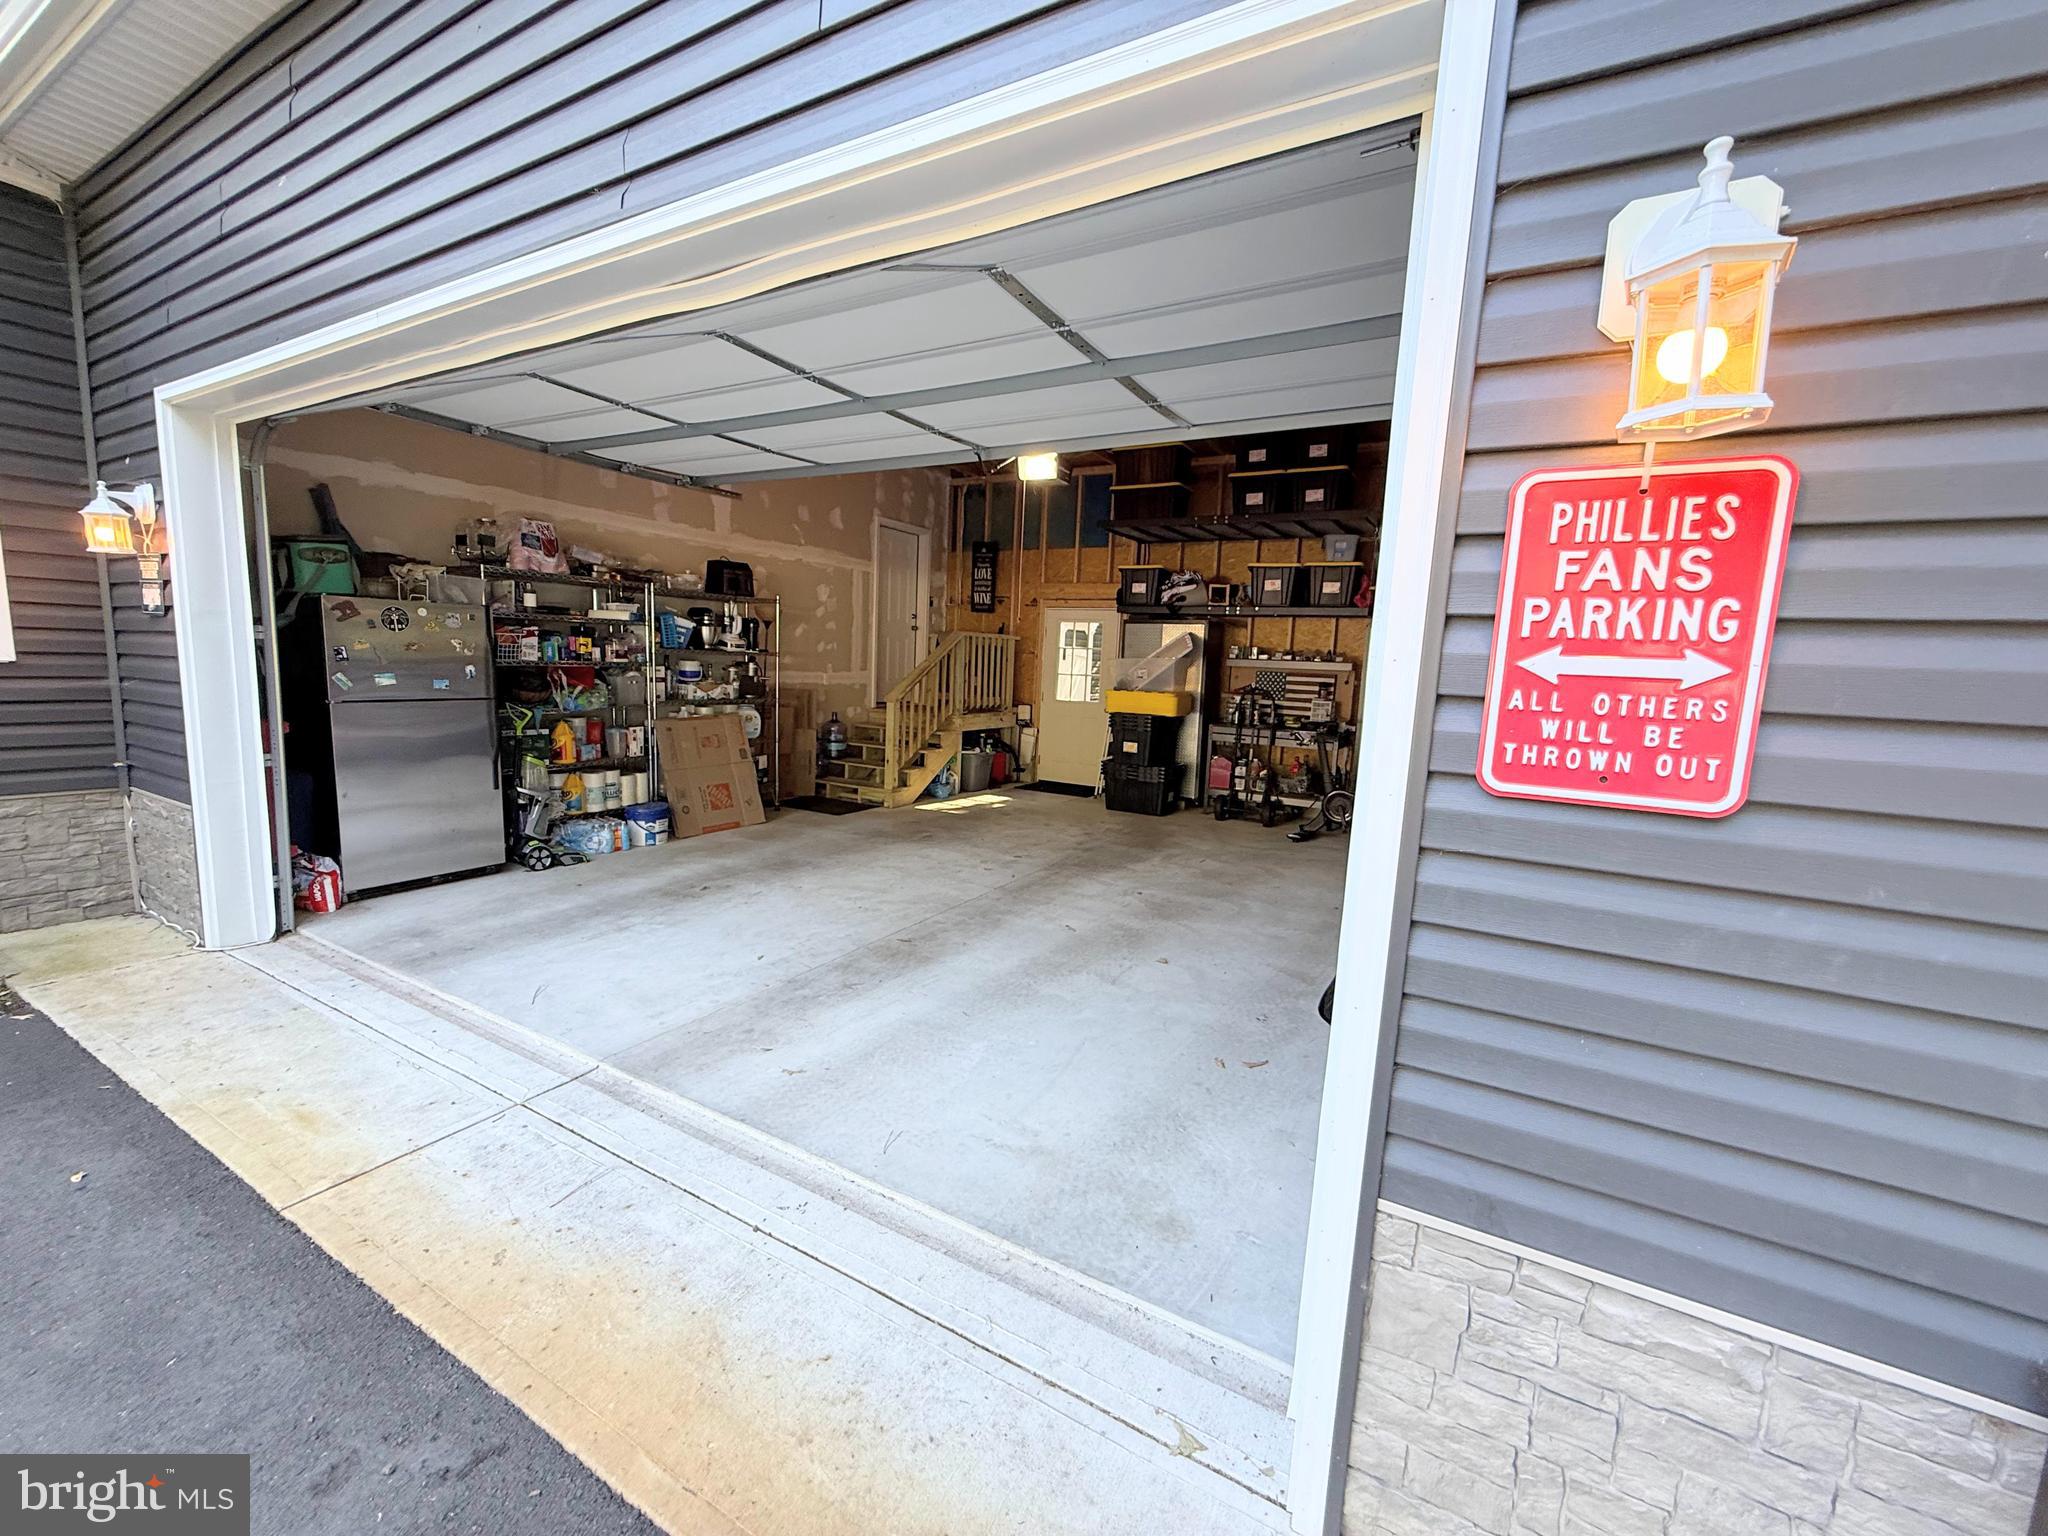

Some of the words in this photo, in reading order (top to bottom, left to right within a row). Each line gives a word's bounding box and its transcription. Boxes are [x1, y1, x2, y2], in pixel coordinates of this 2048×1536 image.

[1549, 493, 1740, 544] PHILLIES
[974, 568, 992, 579] LOVE
[1554, 547, 1713, 592] FANS
[1521, 596, 1740, 643] PARKING
[1507, 689, 1564, 712] ALL
[1593, 693, 1728, 722] OTHERS
[1541, 719, 1613, 745] WILL
[1644, 726, 1684, 749] BE
[1503, 743, 1632, 773] THROWN
[1655, 756, 1722, 781] OUT
